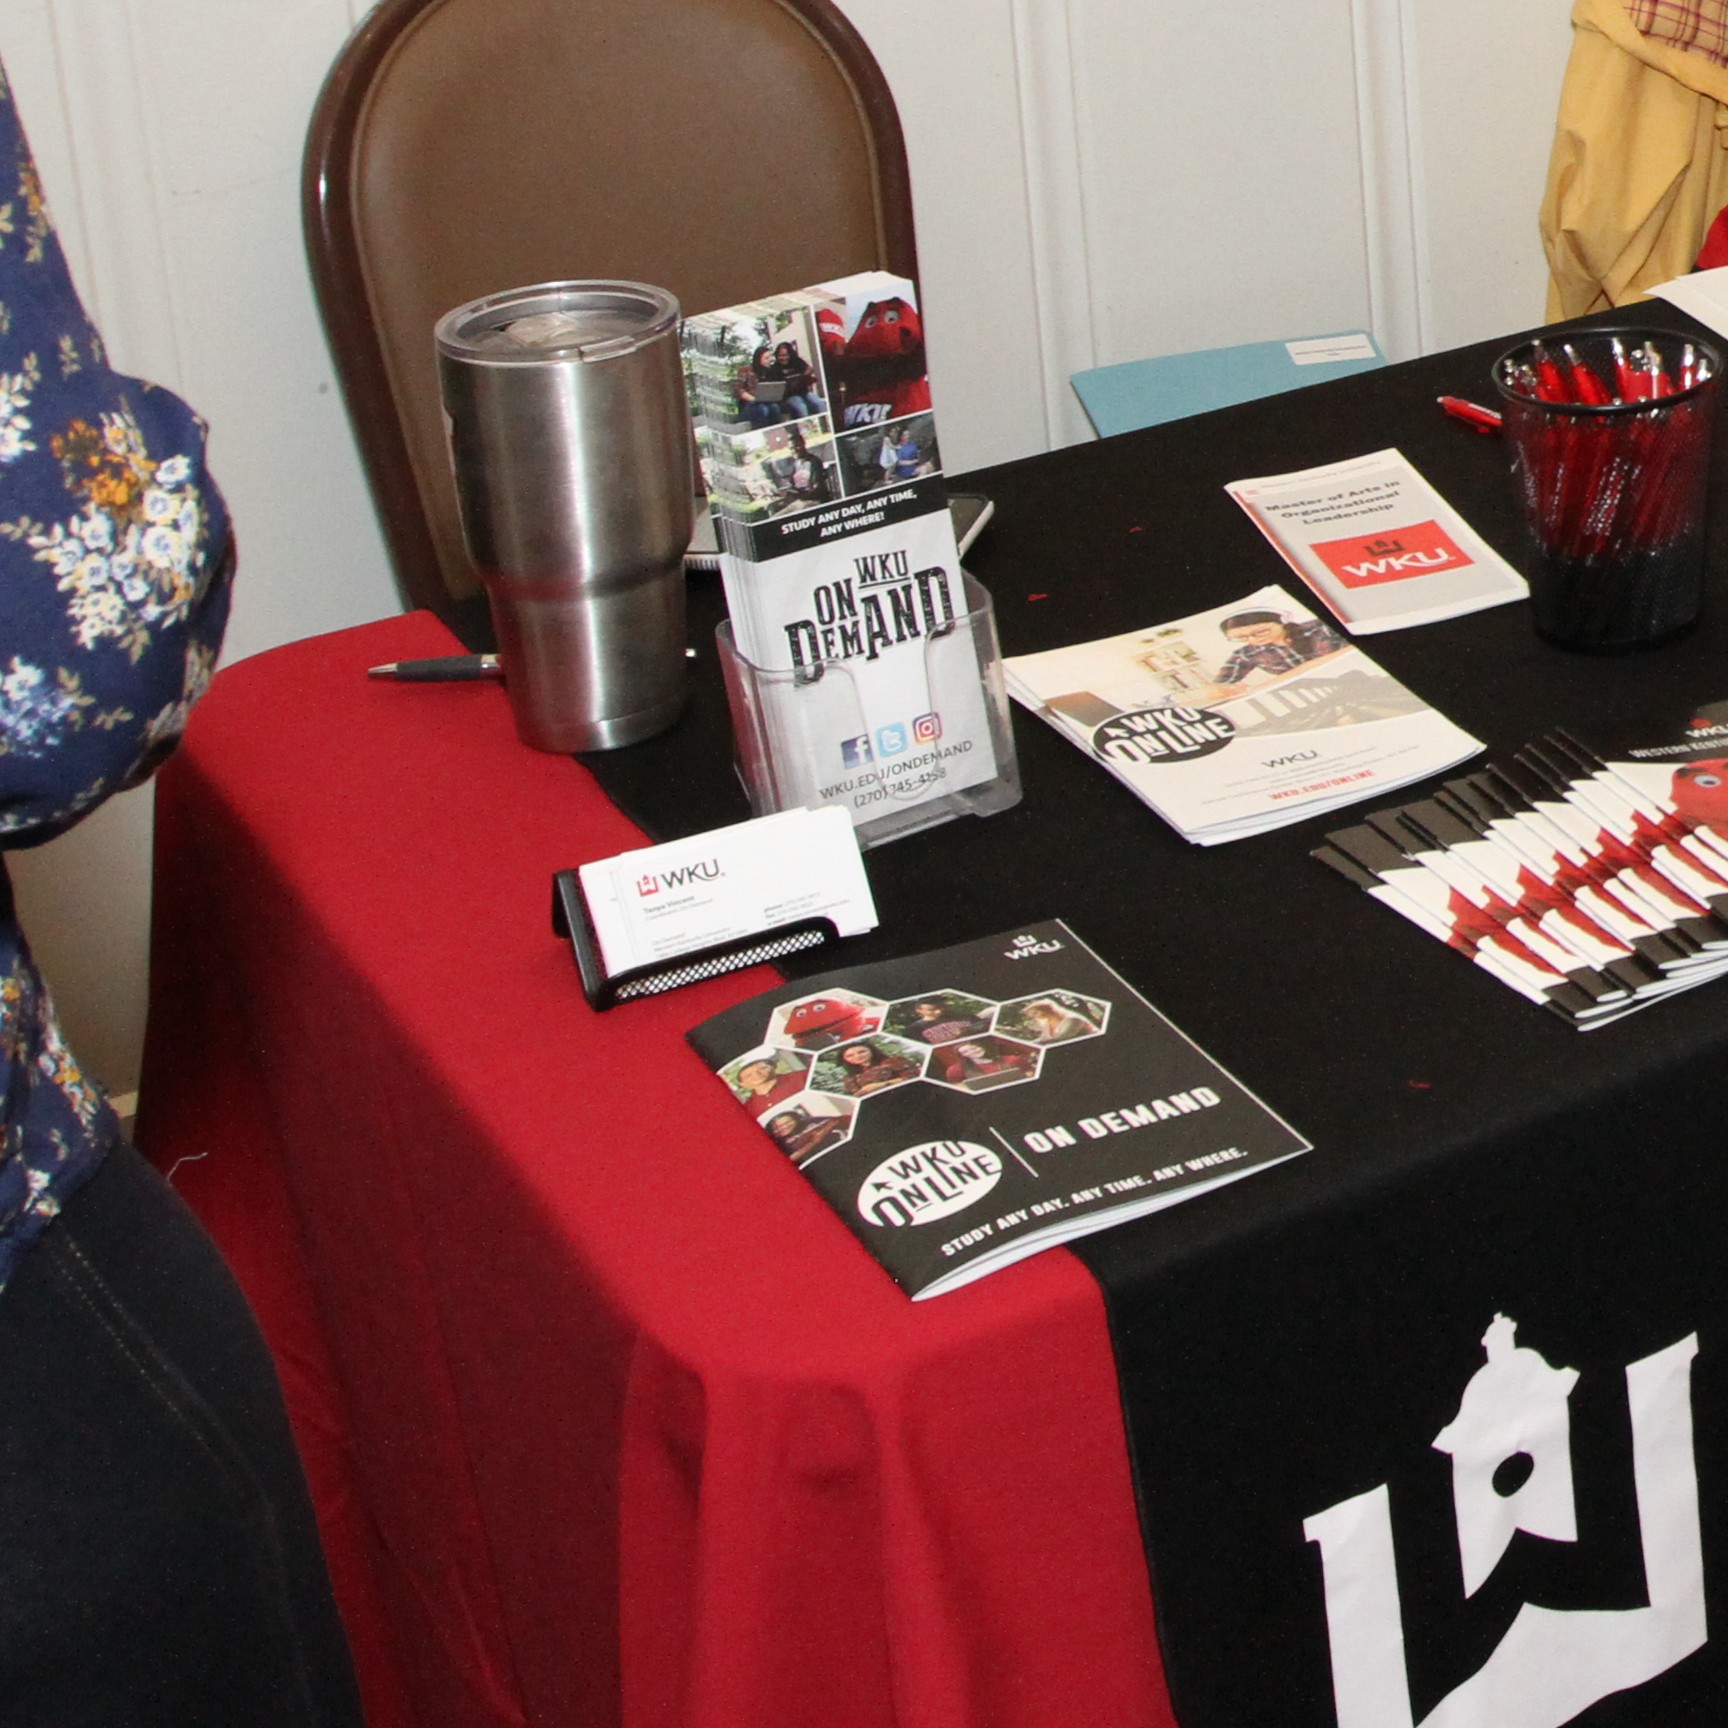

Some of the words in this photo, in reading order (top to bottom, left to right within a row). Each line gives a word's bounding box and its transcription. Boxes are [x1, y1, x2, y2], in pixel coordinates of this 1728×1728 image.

[781, 516, 816, 535] STUDY
[818, 510, 841, 525] ANY
[841, 503, 865, 519] DAY,
[866, 496, 890, 511] ANY
[890, 489, 917, 504] TIME,
[1265, 498, 1323, 512] Master
[1328, 493, 1344, 502] of
[1349, 486, 1381, 498] Arts
[1384, 480, 1401, 488] in
[1281, 490, 1400, 519] Organizational
[820, 524, 843, 538] ANY
[843, 511, 885, 531] WHERE!
[1303, 503, 1394, 526] Leadership
[854, 550, 909, 584] WKU
[1342, 547, 1450, 578] WKU
[814, 577, 857, 626] ON
[784, 566, 955, 688] DEMAND
[1122, 705, 1203, 735] WKU
[1102, 715, 1236, 766] ONLINE
[1628, 742, 1692, 759] WESTERN
[1261, 749, 1319, 768] WKU
[1268, 769, 1376, 801] WKU.EDU/ONLINE
[660, 859, 720, 890] WKU
[1003, 939, 1062, 961] WKU
[1023, 1125, 1077, 1155] ON
[1078, 1086, 1222, 1140] DEMAND
[887, 1140, 967, 1181] WKU
[871, 1150, 1002, 1228] ONLINE
[941, 1223, 994, 1258] STUDY
[996, 1210, 1029, 1231] ANY
[1071, 1185, 1106, 1206] ANY
[1153, 1163, 1185, 1184] ANY
